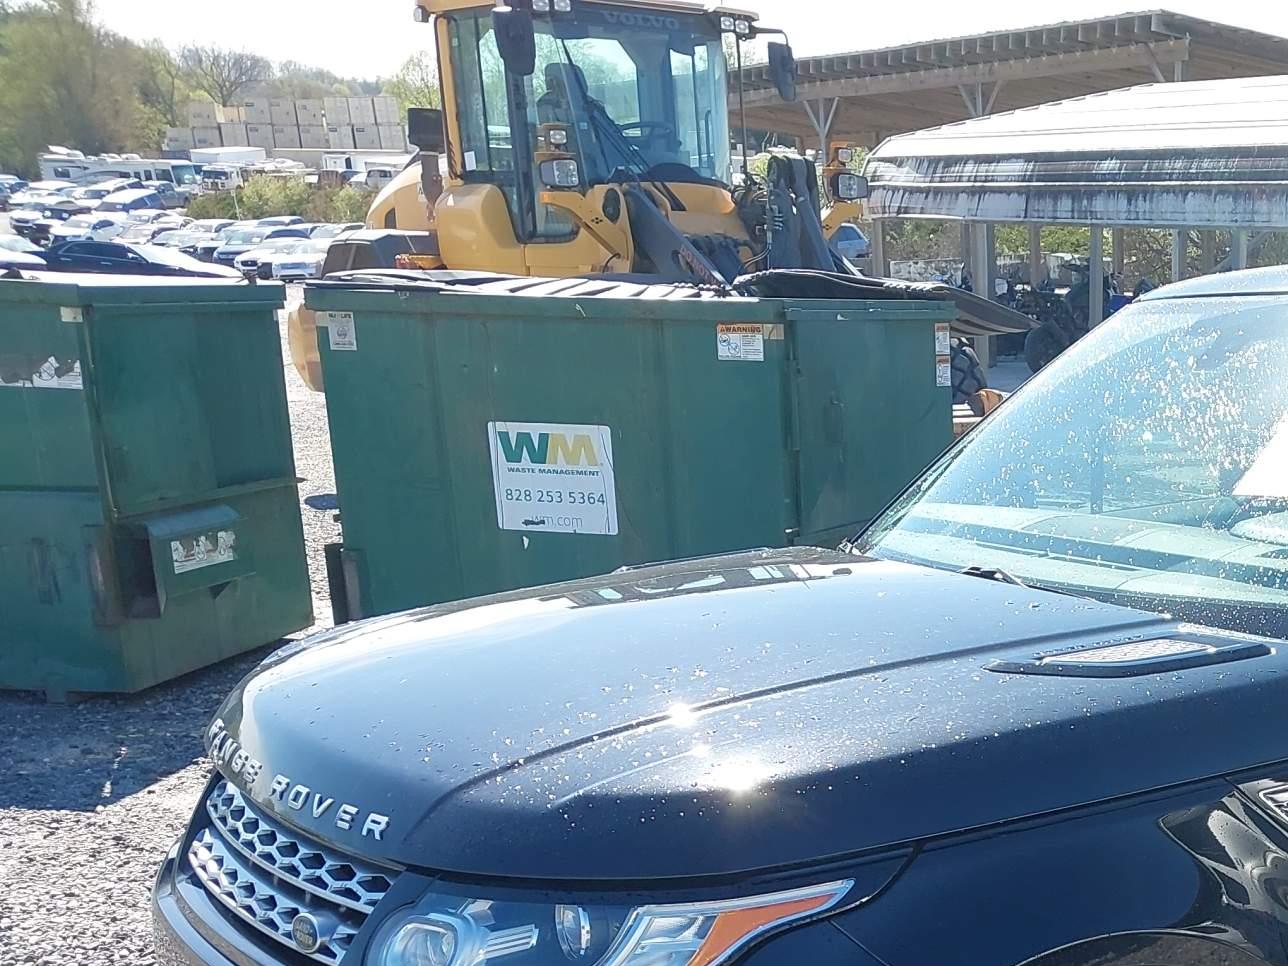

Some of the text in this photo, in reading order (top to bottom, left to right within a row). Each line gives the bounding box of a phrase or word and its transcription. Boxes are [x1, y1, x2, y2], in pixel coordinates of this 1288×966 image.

[602, 11, 679, 29] VOLVO
[498, 431, 599, 466] WM
[507, 466, 600, 477] WASTE MANAGEMENT
[505, 488, 606, 505] 828 253 5364
[208, 718, 390, 841] RANGE ROVER
